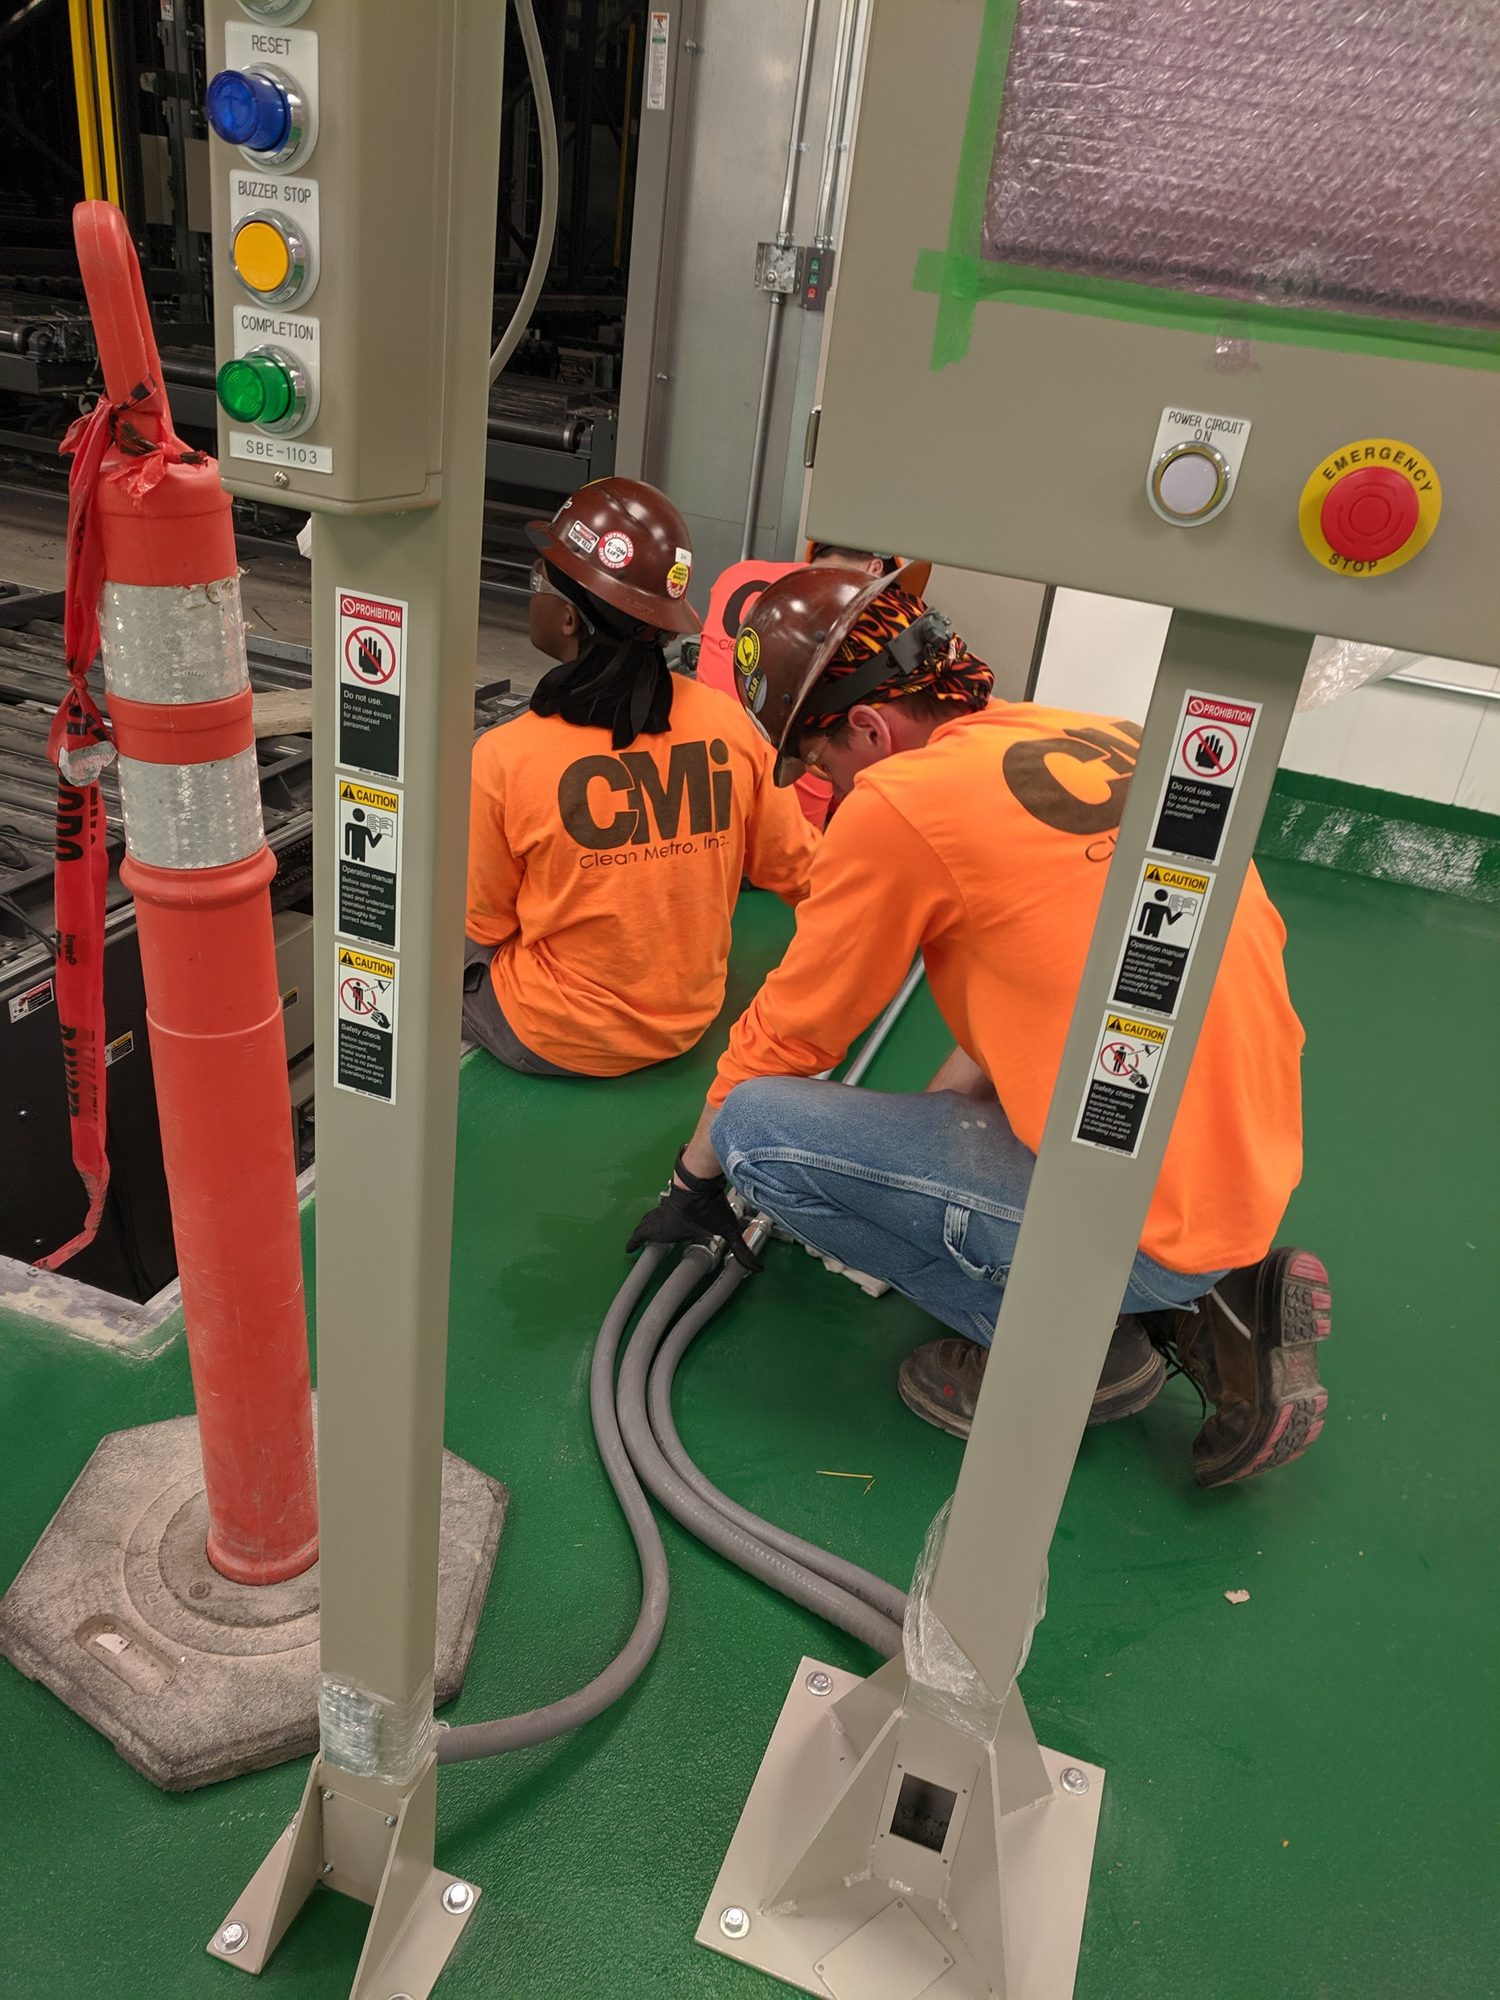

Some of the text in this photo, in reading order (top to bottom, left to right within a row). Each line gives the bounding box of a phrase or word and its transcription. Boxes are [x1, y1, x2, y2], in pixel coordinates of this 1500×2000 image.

[252, 35, 292, 55] RESET
[238, 180, 312, 203] BUZZER STOP
[241, 316, 314, 340] COMPLETION
[1168, 412, 1244, 434] POWER CIRCUIT
[1194, 429, 1212, 442] ON
[246, 441, 318, 464] SBE-1103
[1322, 447, 1432, 492] EMERGENCY
[605, 533, 633, 557] AUTHORIZED
[599, 547, 625, 568] OPERATOR
[1328, 553, 1378, 572] STOP
[356, 602, 400, 623] PROHIBITION
[344, 690, 382, 706] Do not use.
[374, 711, 391, 720] except
[1204, 704, 1251, 722] PROHIBITION
[558, 738, 732, 850] CMi
[1172, 781, 1183, 790] Do
[357, 790, 396, 808] CAUTION
[580, 836, 729, 869] Clean Metro, Inc.
[342, 865, 393, 884] Operation manual
[1163, 872, 1206, 890] CAUTION
[355, 957, 393, 975] CAUTION
[341, 1024, 361, 1035] Safety
[1124, 1023, 1164, 1041] CAUTION
